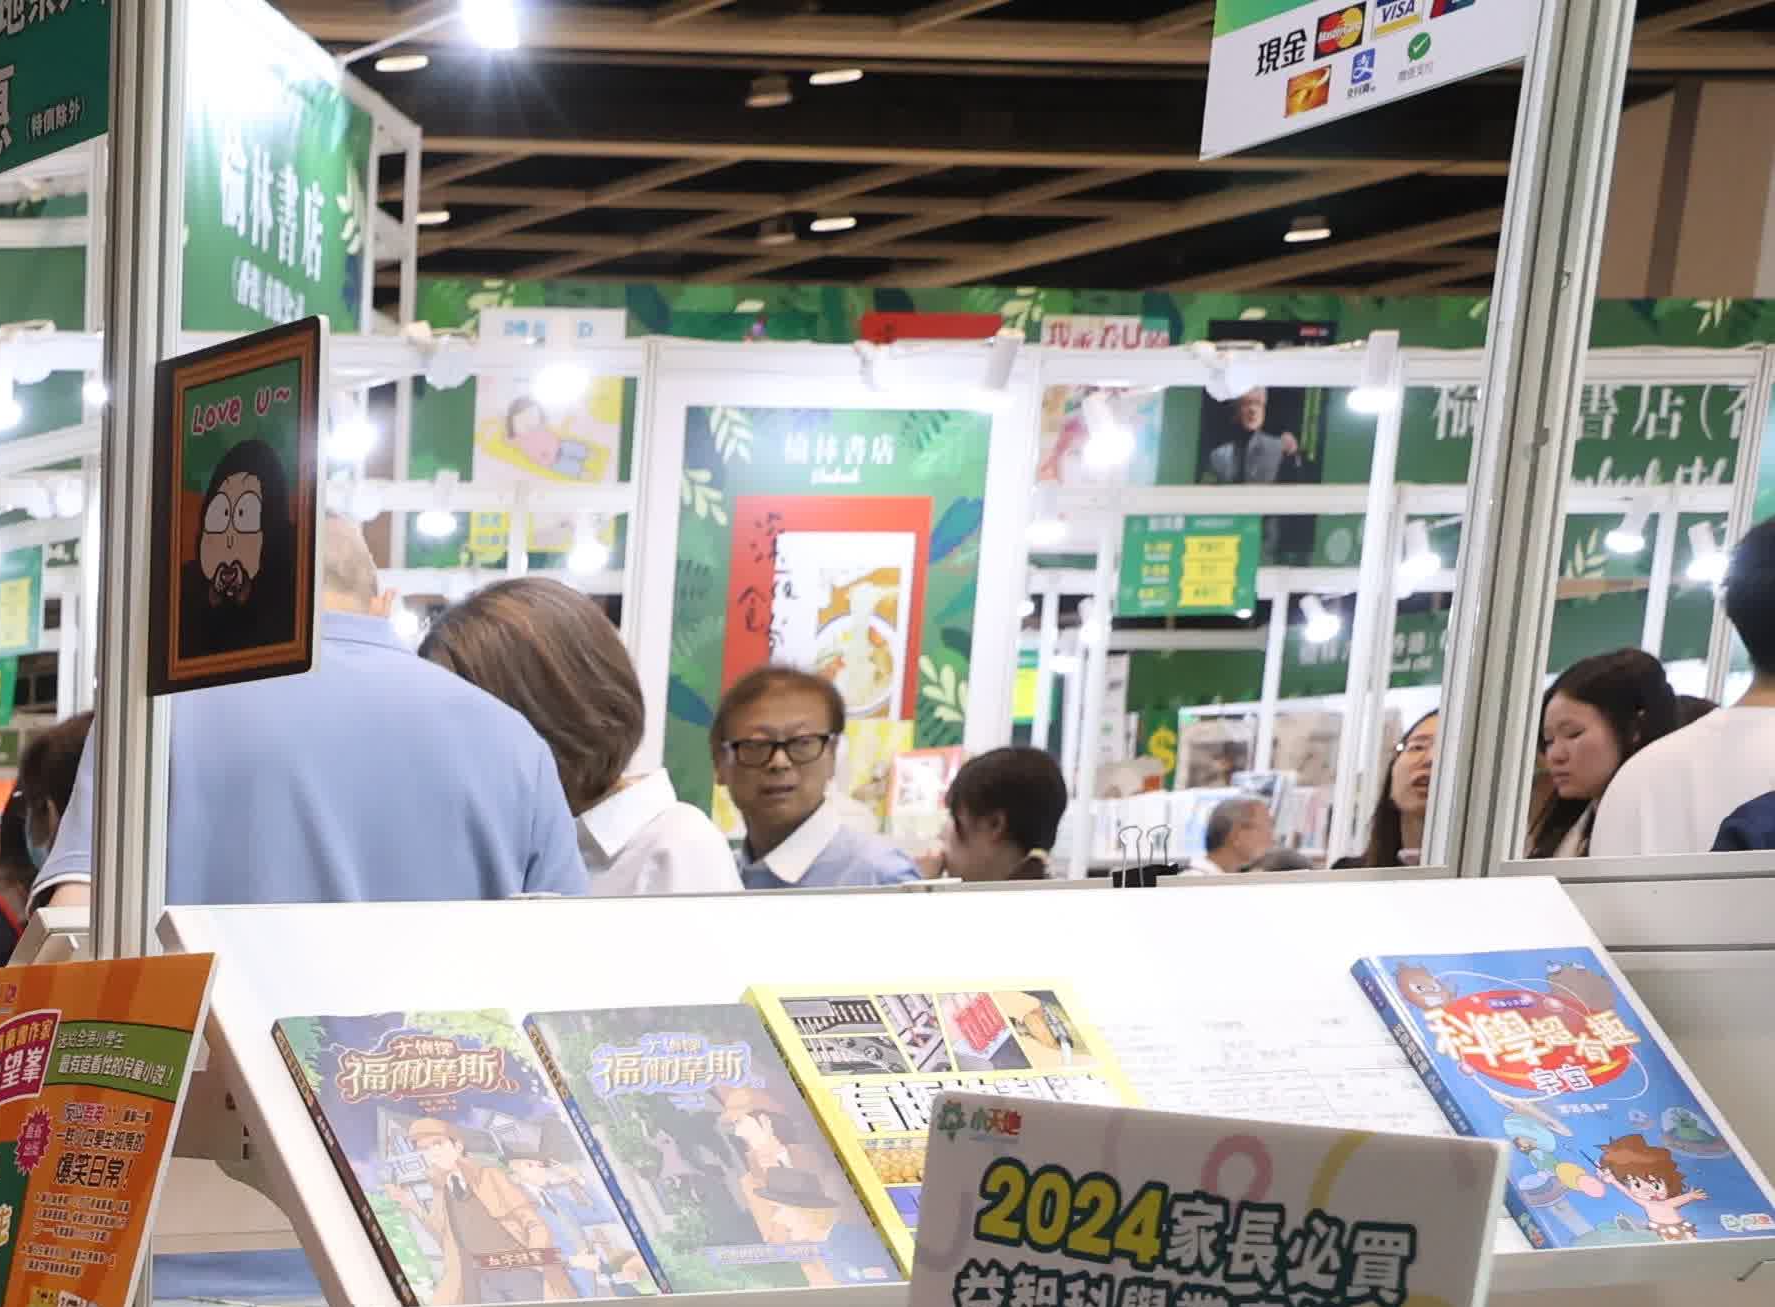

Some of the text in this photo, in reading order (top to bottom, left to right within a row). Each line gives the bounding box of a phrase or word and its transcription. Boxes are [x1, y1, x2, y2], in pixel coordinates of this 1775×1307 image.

[1381, 0, 1416, 24] VISA
[1255, 28, 1307, 77] 現金
[343, 1052, 499, 1098] 福爾摩斯
[594, 1050, 744, 1093] 福爾摩斯
[1528, 1063, 1595, 1097] 宇宙
[975, 1157, 1416, 1299] 2024家長必買
